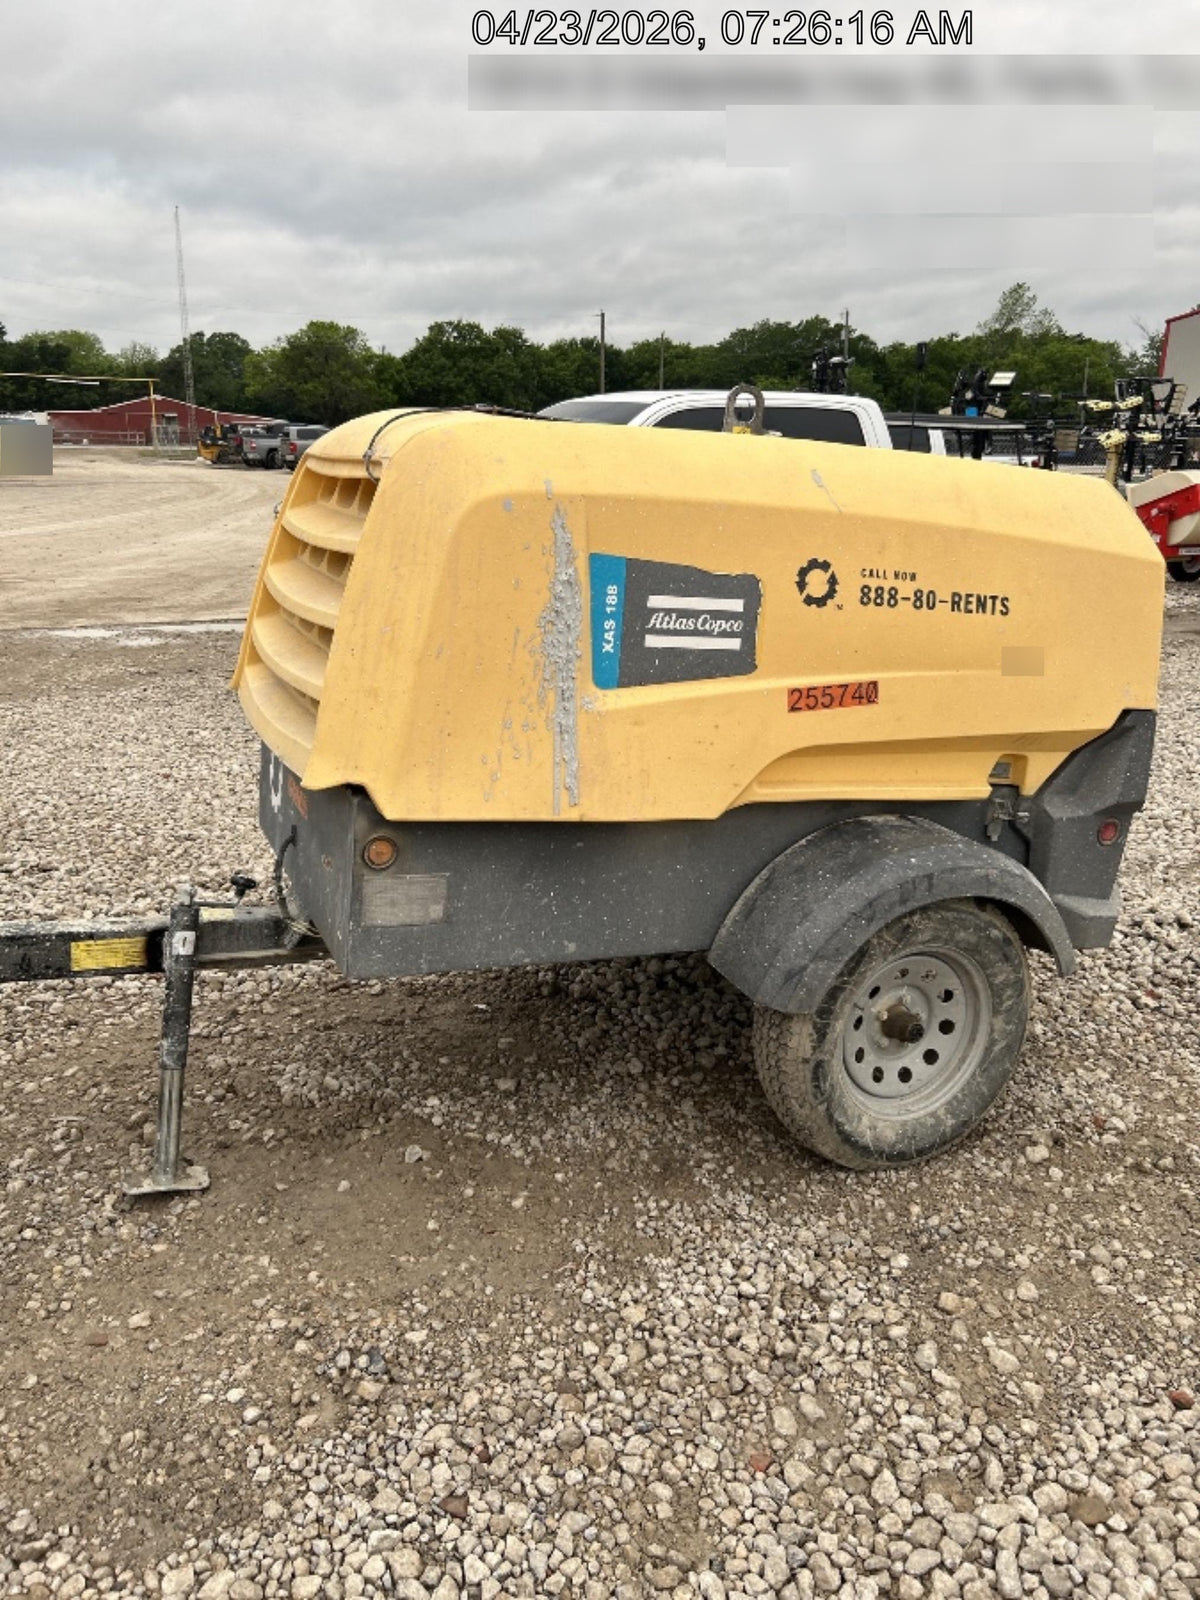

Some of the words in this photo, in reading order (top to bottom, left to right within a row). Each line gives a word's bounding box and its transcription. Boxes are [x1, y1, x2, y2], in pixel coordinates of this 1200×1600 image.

[860, 568, 888, 580] CALL
[894, 570, 917, 582] NOW
[859, 584, 1010, 616] 888-80-RENTS
[602, 619, 616, 653] XAS
[645, 611, 696, 631] Atlas
[696, 614, 744, 635] Copco
[789, 681, 878, 712] 255740
